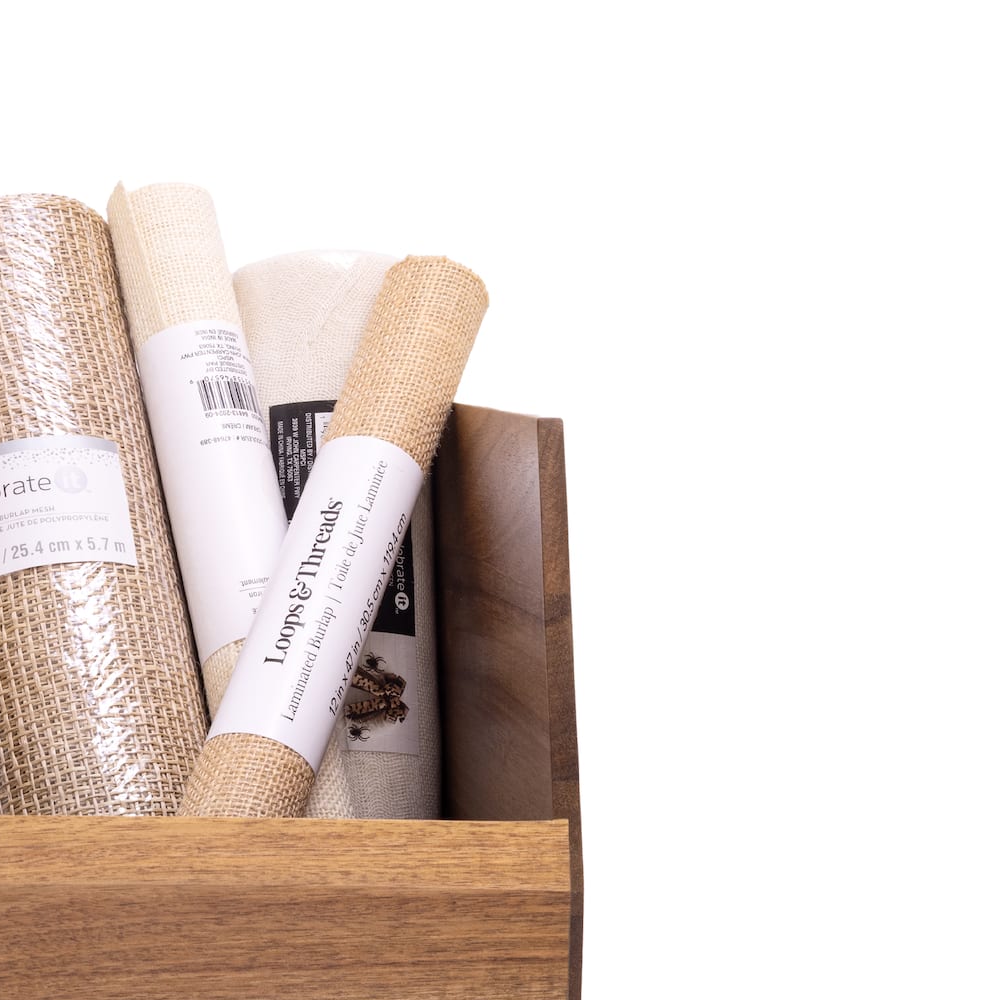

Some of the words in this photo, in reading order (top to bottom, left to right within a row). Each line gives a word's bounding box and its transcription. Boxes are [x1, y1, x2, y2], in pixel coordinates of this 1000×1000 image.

[358, 459, 389, 512] Laminée
[0, 509, 30, 521] BURLAP
[6, 520, 25, 531] JUTE
[347, 514, 369, 545] Jute
[11, 541, 44, 560] 25.4
[48, 540, 70, 553] cm
[75, 539, 83, 551] x
[87, 537, 109, 551] 5.7
[114, 541, 126, 553] m
[295, 499, 343, 581] Threads
[342, 541, 358, 557] de
[328, 558, 352, 589] Toile
[289, 581, 312, 600] &
[307, 606, 337, 651] Burlap
[328, 697, 338, 717] 12
[334, 685, 345, 700] in
[345, 652, 353, 673] 47
[351, 641, 360, 655] in
[359, 598, 374, 632] 30.5
[372, 579, 383, 601] cm
[397, 513, 407, 535] cm
[263, 603, 306, 665] Loops
[280, 650, 318, 722] Laminated
